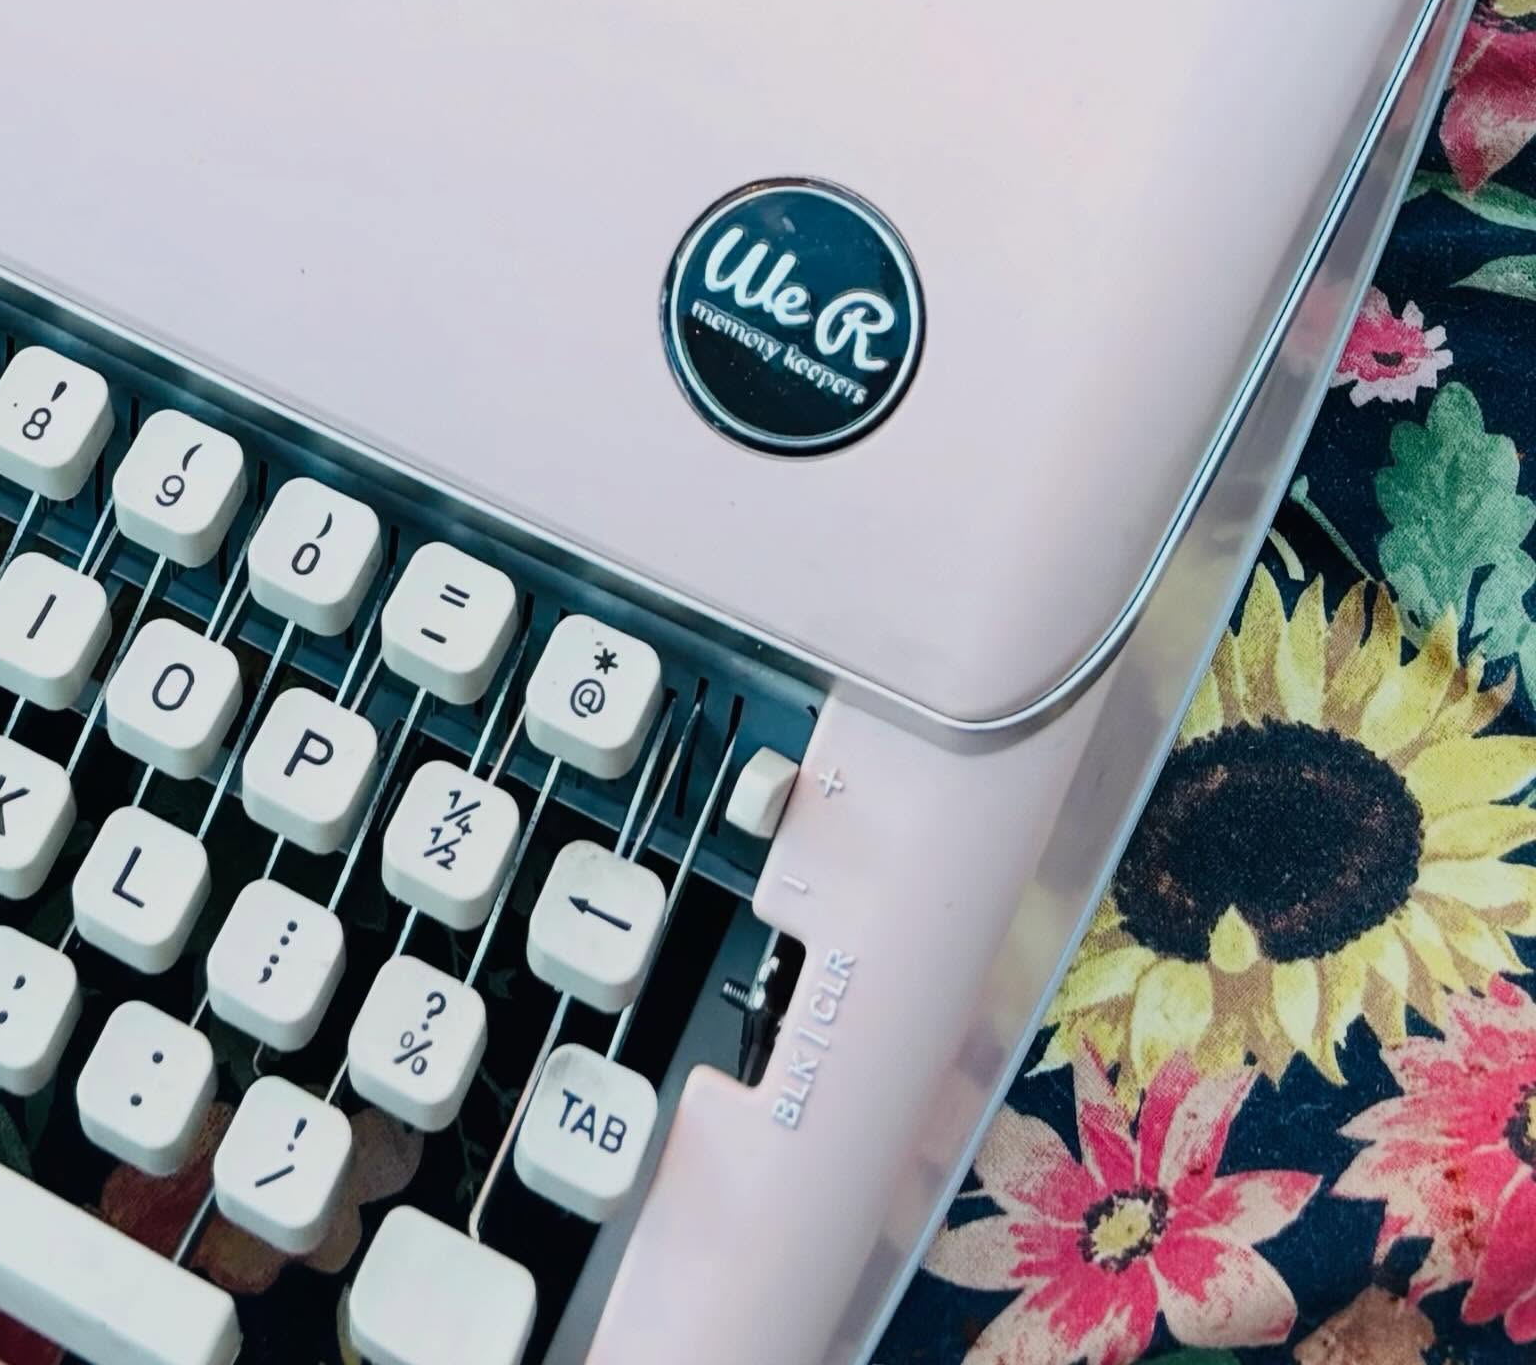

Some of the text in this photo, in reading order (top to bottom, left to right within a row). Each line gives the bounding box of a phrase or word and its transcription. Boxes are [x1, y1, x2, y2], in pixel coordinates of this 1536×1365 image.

[704, 226, 897, 371] We R
[690, 300, 869, 405] memory keepers
[21, 407, 52, 441] 8
[155, 474, 186, 507] 9
[291, 542, 321, 576] 0
[26, 594, 57, 640] I
[151, 662, 195, 712] O
[569, 678, 606, 719] @
[283, 728, 334, 778] P
[111, 846, 145, 909] L
[421, 991, 447, 1032] ?
[394, 1030, 433, 1076] %
[287, 1118, 308, 1152] !
[559, 1088, 627, 1154] TAB
